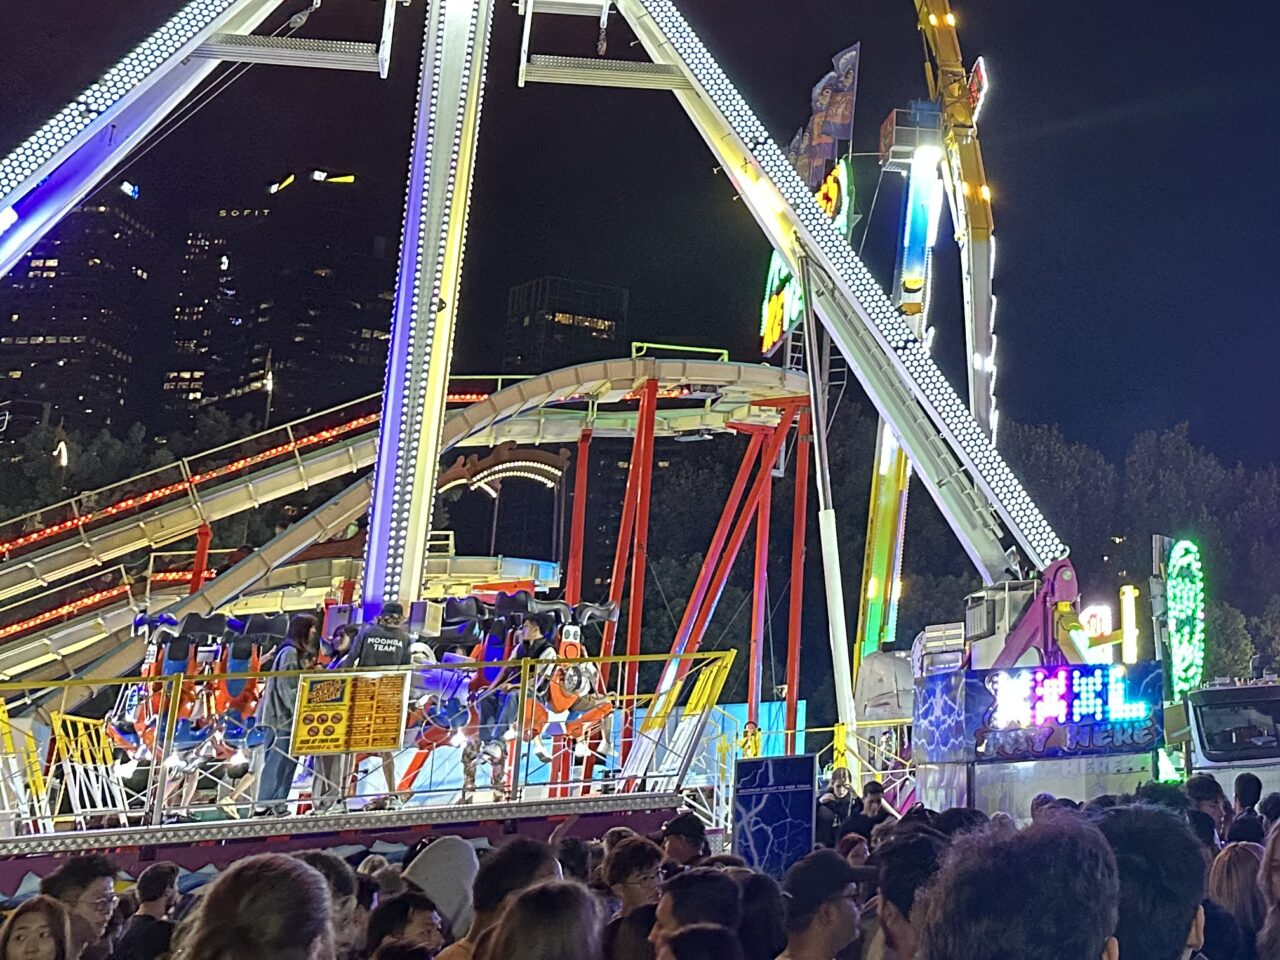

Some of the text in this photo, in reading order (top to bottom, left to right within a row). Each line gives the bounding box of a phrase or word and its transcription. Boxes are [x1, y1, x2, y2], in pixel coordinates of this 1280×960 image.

[218, 208, 271, 218] SOFIT
[367, 636, 403, 649] MOOMBA
[373, 643, 397, 653] TEAM
[976, 719, 1154, 759] PAY HERE
